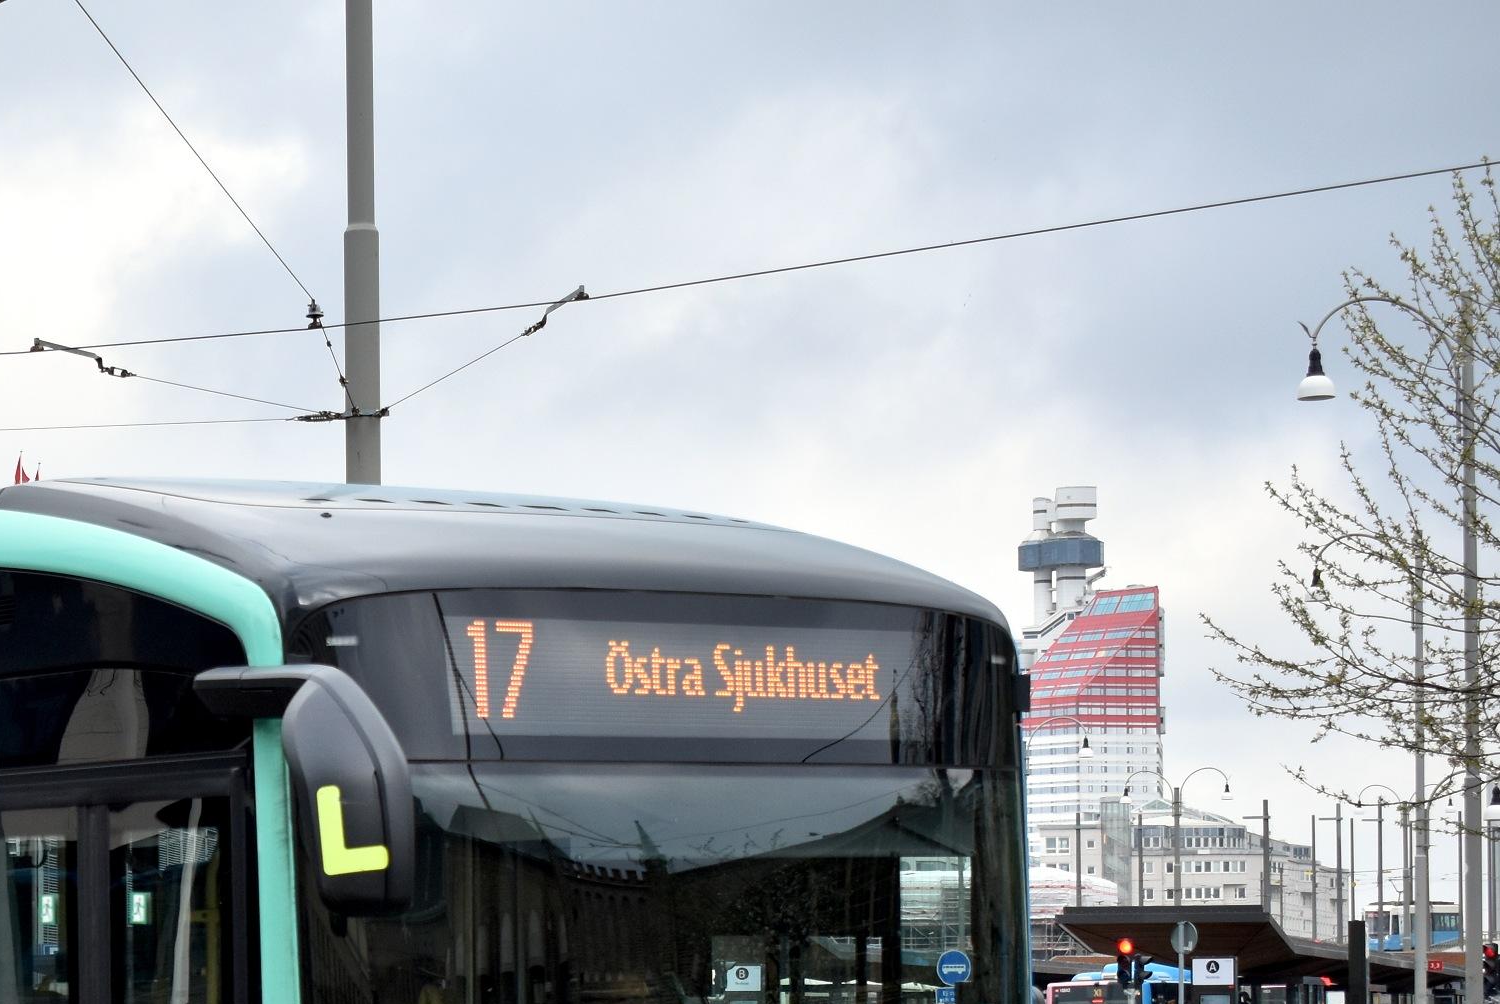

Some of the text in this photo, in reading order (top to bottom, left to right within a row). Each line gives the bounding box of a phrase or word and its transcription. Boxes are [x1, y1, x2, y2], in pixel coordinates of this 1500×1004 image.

[467, 619, 881, 719] 17 Östra Sjukhuset
[1209, 962, 1217, 972] A
[738, 969, 746, 979] B
